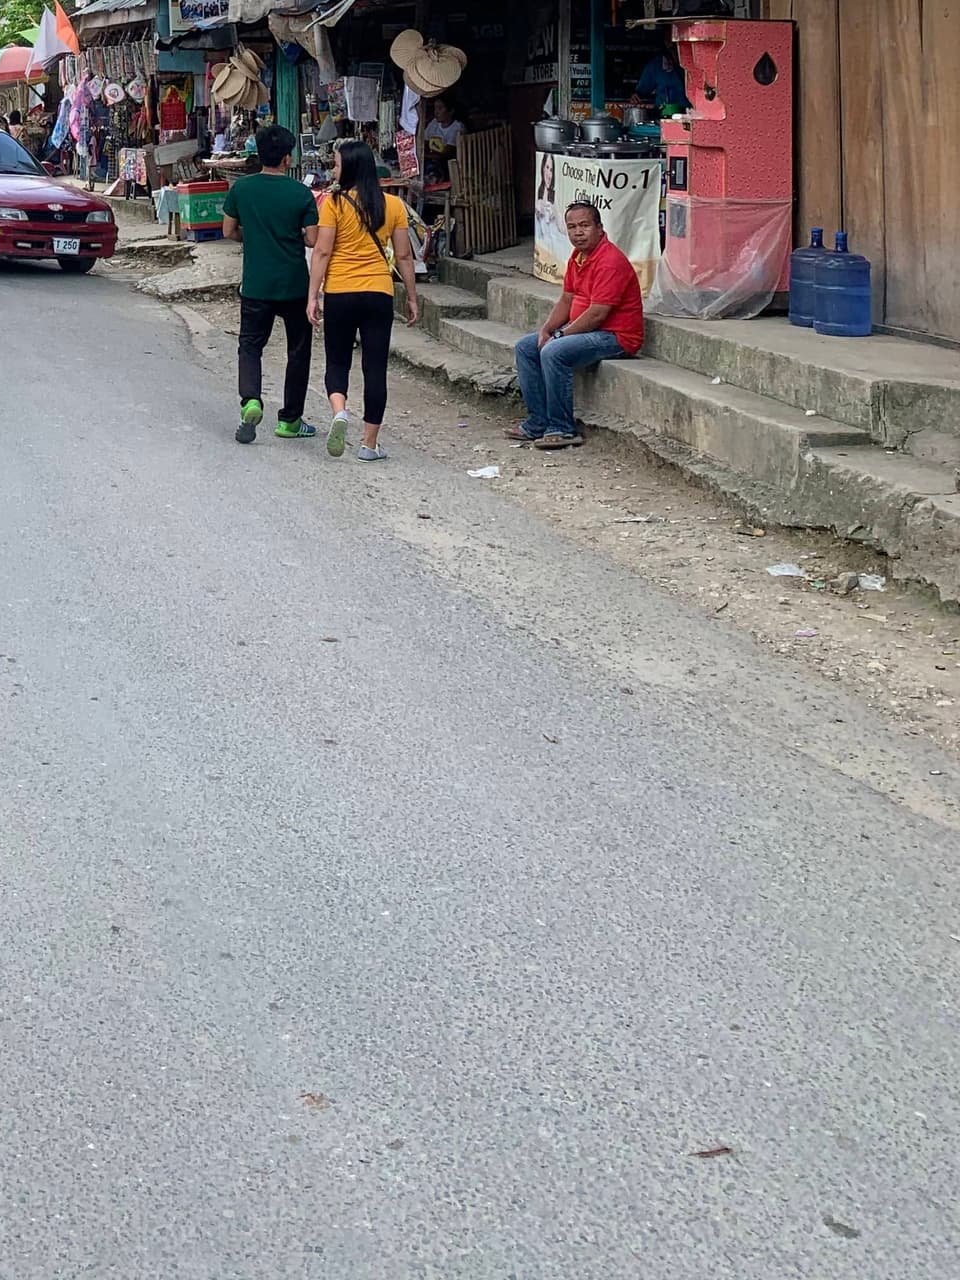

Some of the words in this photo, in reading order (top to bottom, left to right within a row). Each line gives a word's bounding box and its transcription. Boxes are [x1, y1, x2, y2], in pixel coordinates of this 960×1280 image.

[532, 63, 555, 82] STORE
[561, 161, 584, 182] Choose
[585, 168, 596, 186] The
[62, 240, 78, 250] 250
